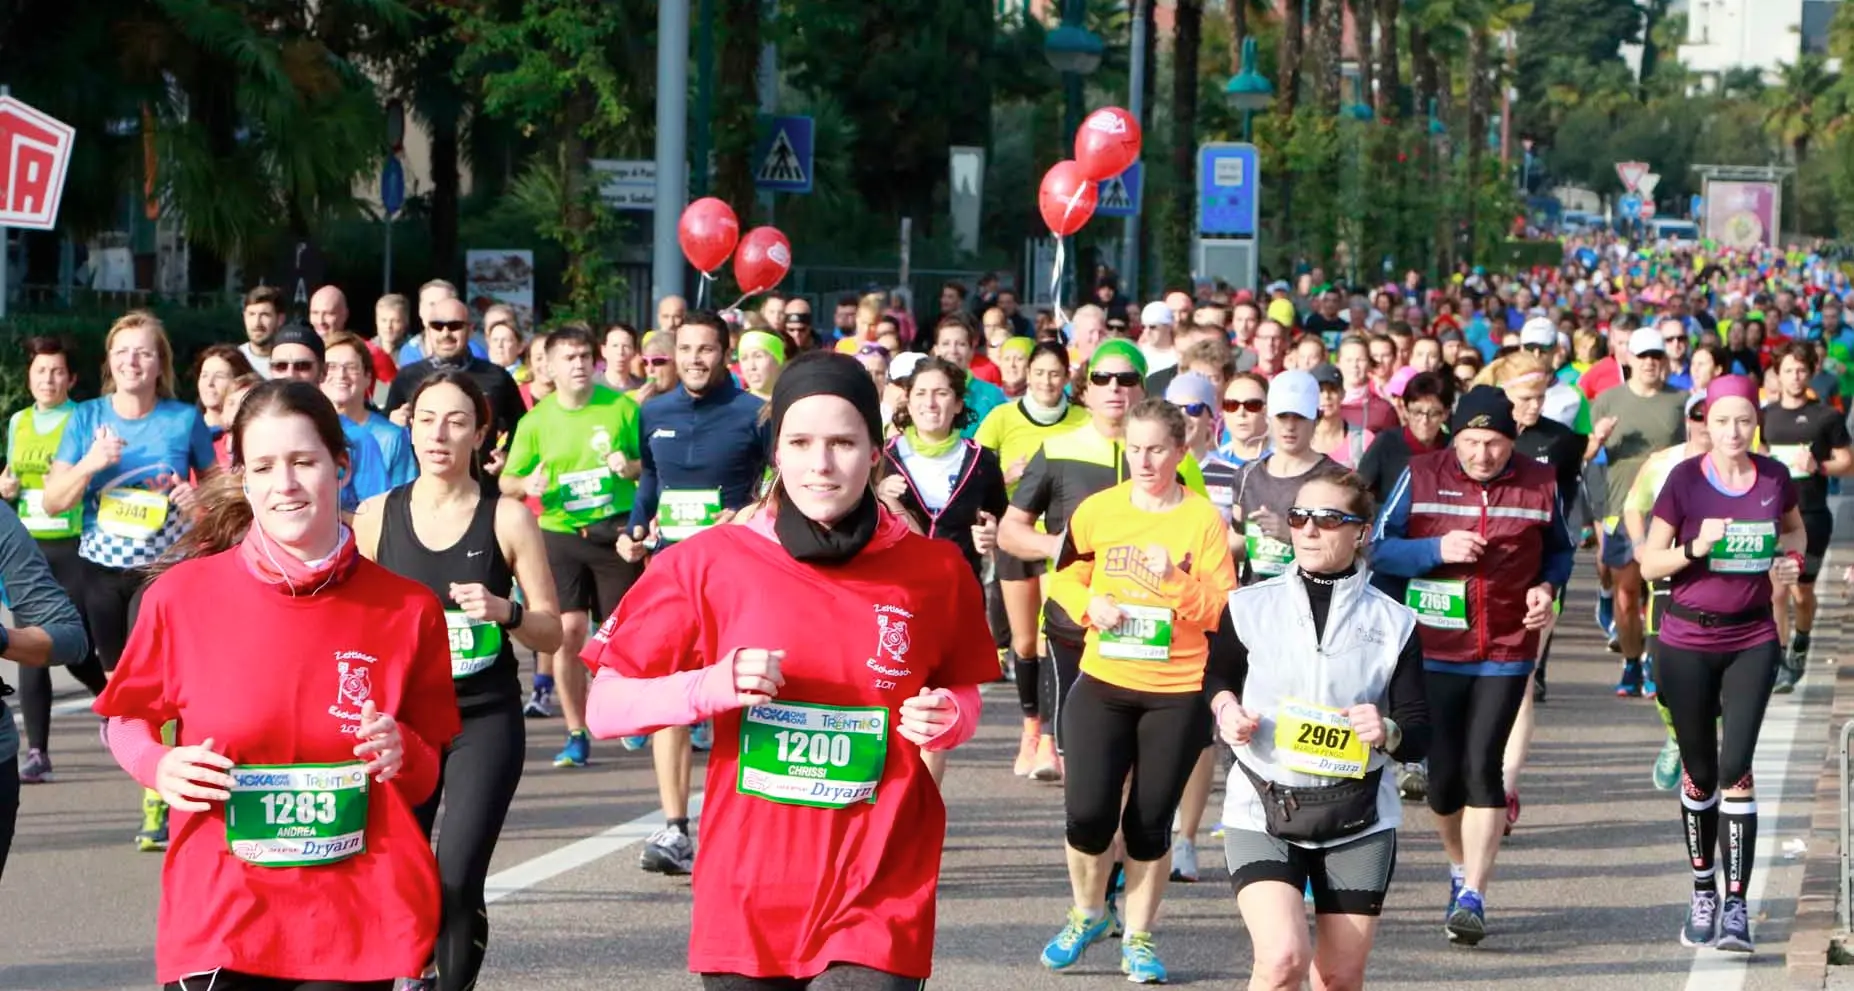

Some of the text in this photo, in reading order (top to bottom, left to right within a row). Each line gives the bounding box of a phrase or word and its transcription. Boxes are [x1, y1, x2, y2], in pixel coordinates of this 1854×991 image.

[1419, 591, 1452, 611] 2769
[448, 627, 475, 652] 59
[750, 705, 791, 724] HOKA
[1297, 723, 1351, 751] 2967
[774, 730, 851, 767] 1200
[788, 765, 827, 778] CHRISSI
[1319, 758, 1361, 773] Dryarn
[234, 774, 274, 787] HOKA
[810, 782, 872, 802] Dryarn
[260, 791, 336, 825] 1283
[276, 827, 317, 837] ANDREA
[301, 837, 360, 857] Dryarn
